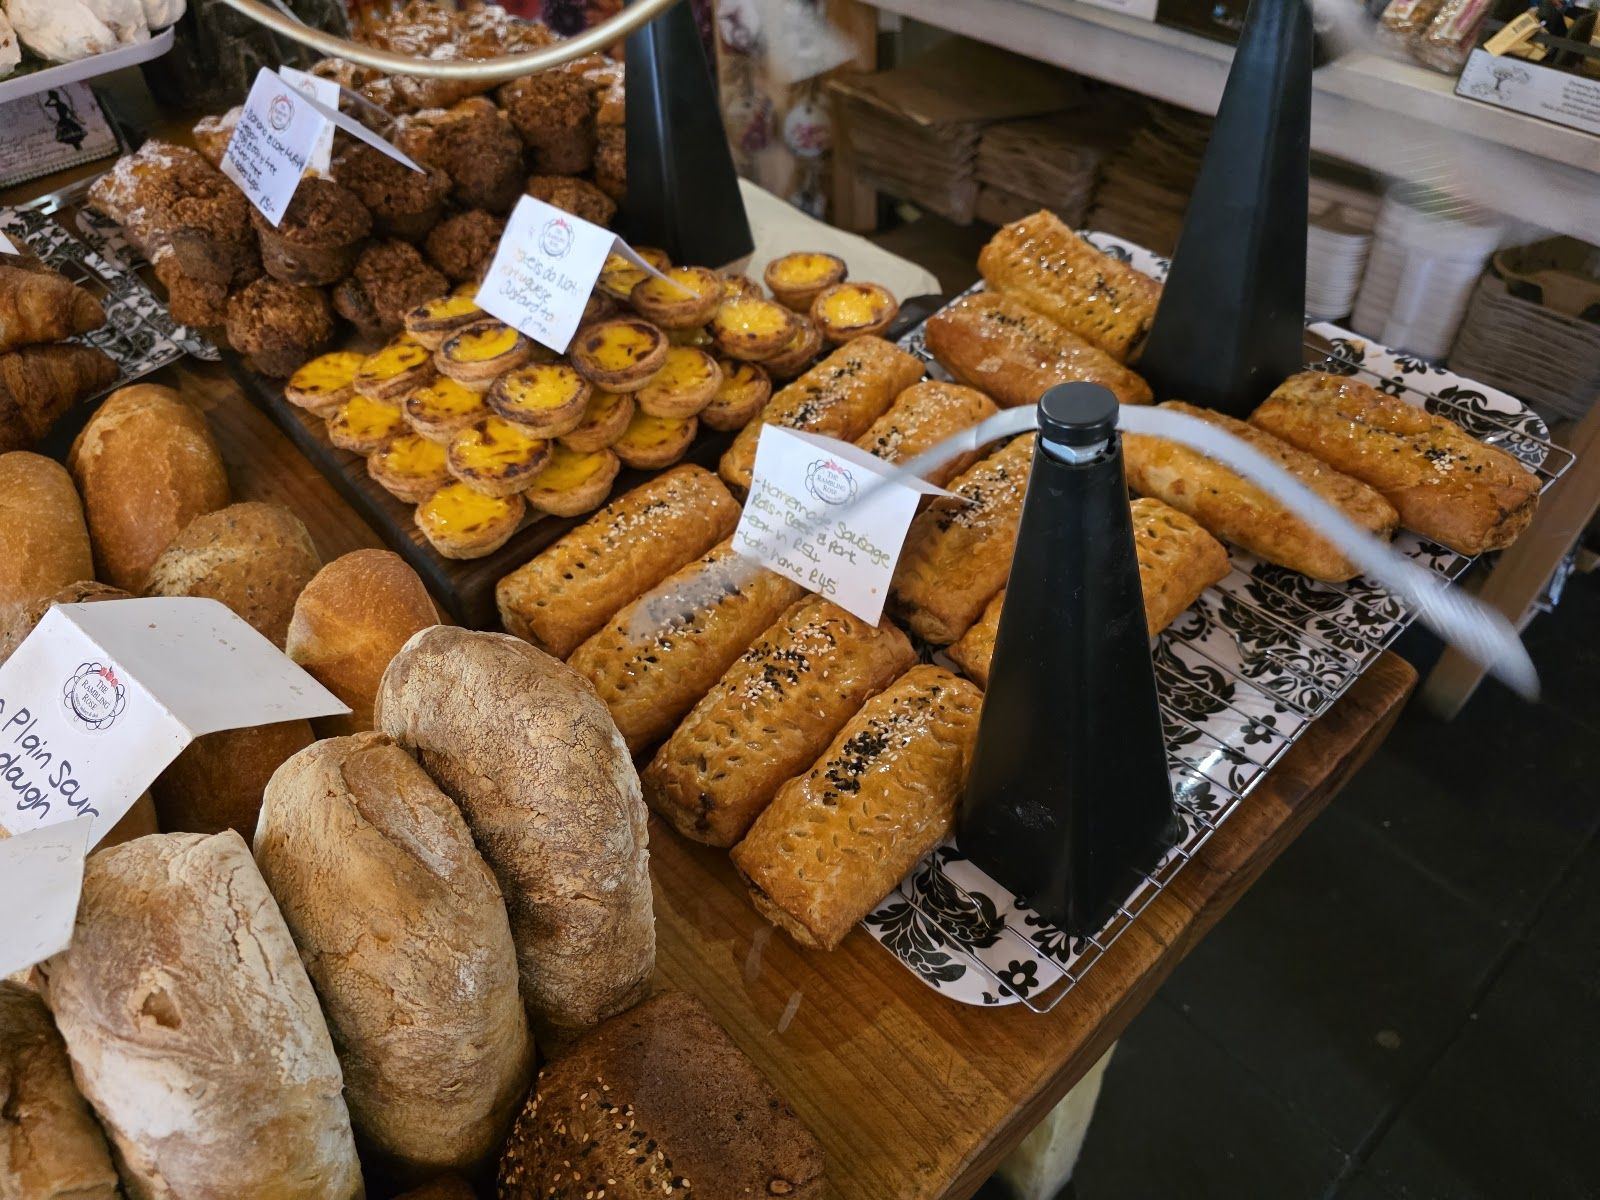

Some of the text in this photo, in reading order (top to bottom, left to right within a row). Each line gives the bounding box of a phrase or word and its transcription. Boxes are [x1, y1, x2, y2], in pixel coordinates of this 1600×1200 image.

[834, 521, 890, 569] Sausage
[808, 568, 837, 594] R45
[81, 680, 110, 710] RAMBLING
[96, 679, 109, 694] THE
[82, 693, 98, 711] ROSE
[2, 707, 52, 770] Plain
